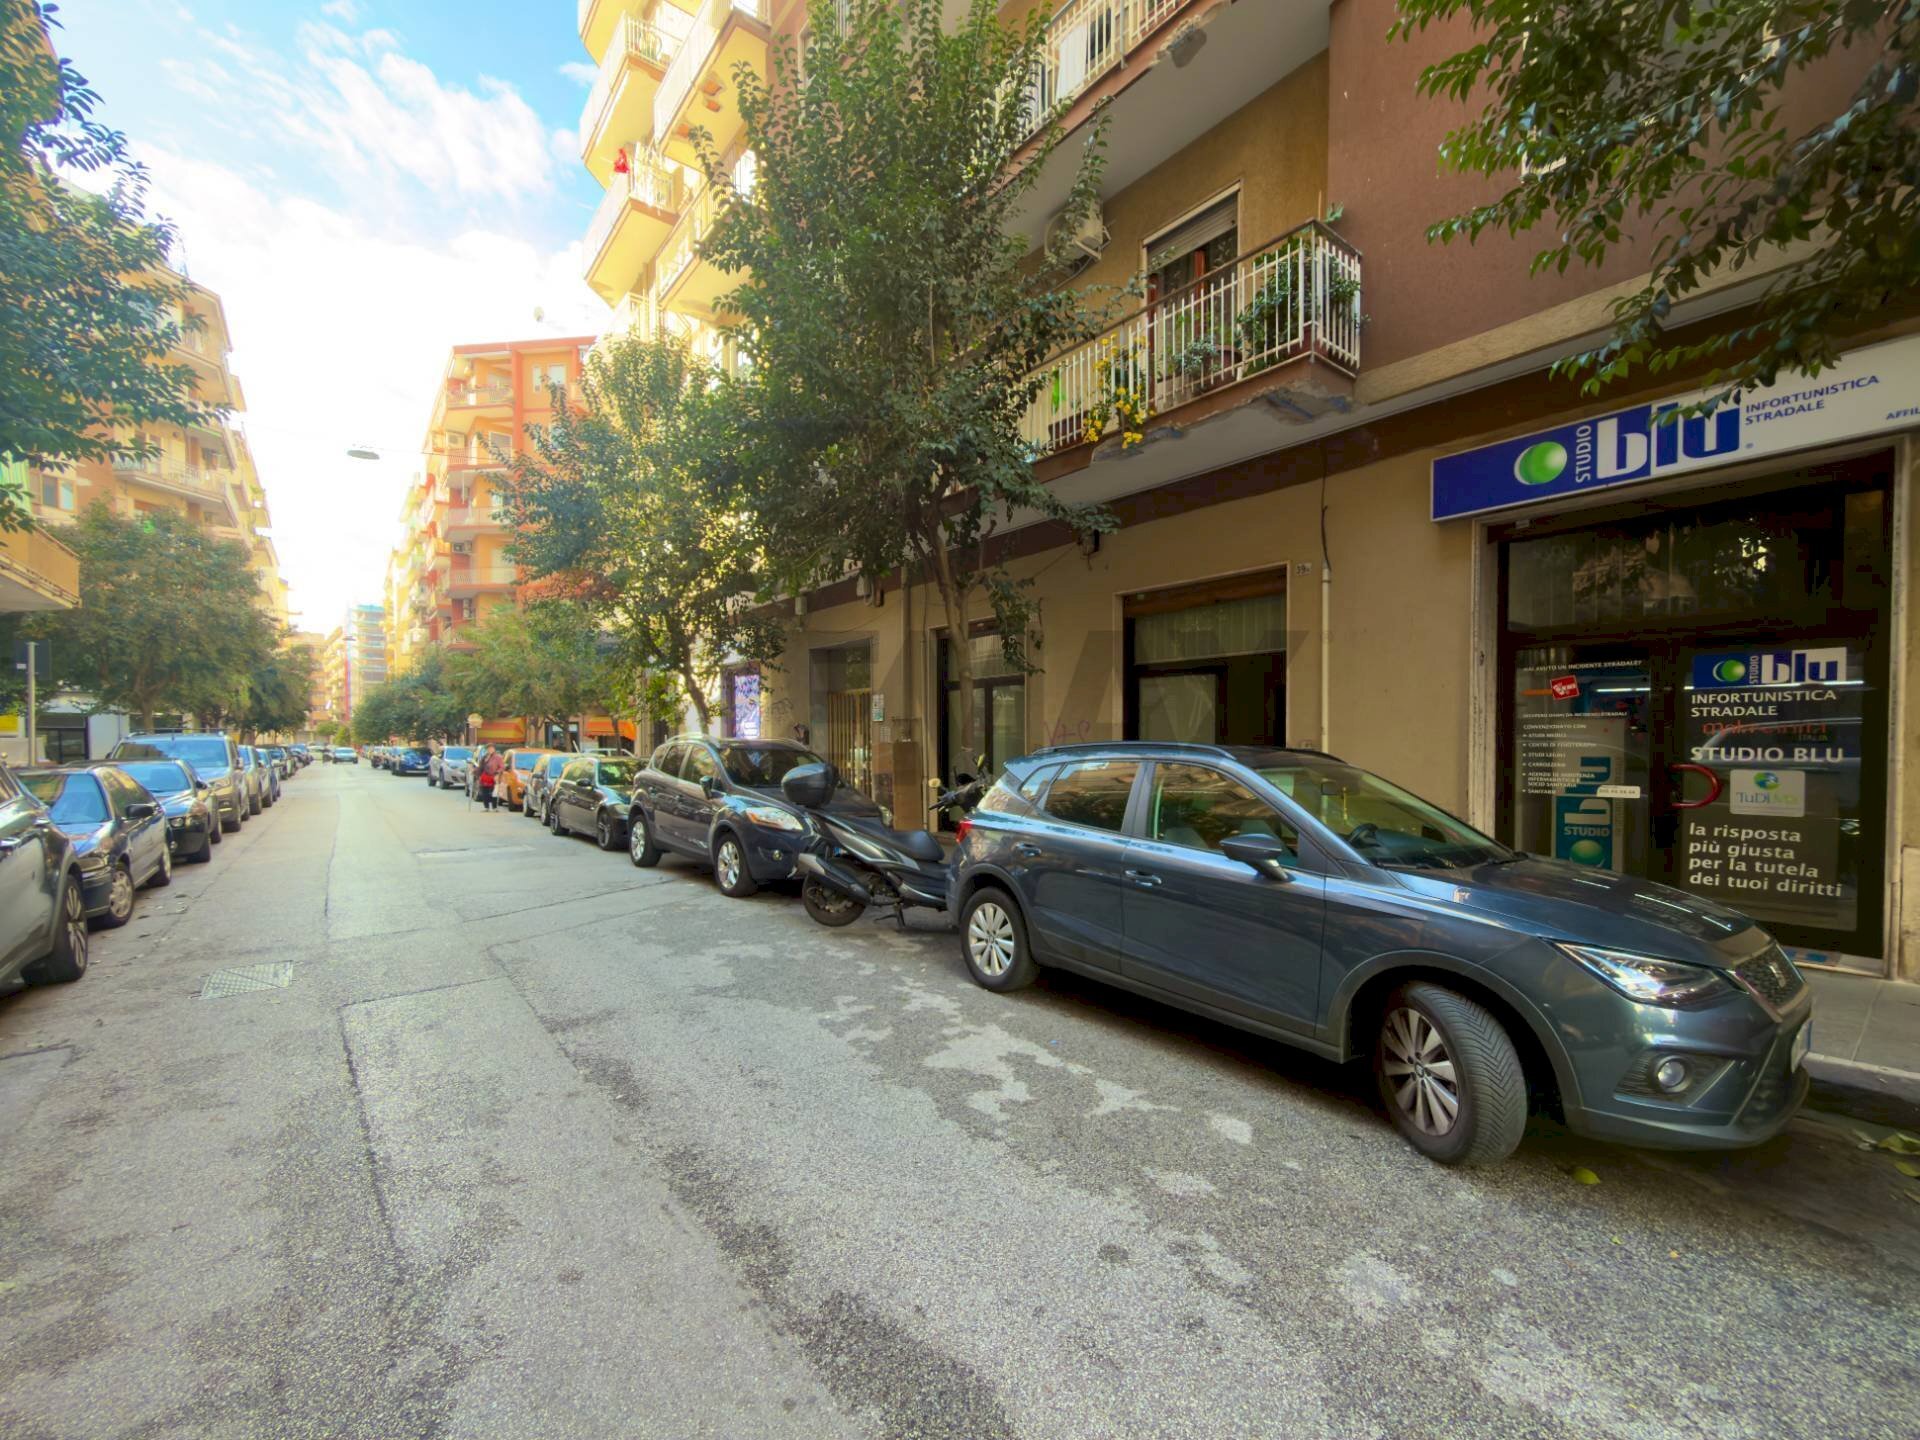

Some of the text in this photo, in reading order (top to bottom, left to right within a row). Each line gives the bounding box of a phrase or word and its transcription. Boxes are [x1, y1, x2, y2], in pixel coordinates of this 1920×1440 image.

[1745, 374, 1881, 414] INFORTUNISTICA
[1744, 398, 1825, 426] STRADALE
[1597, 398, 1739, 480] blu
[1575, 424, 1592, 483] STUDIO
[1749, 655, 1760, 685] STUDIO
[1761, 651, 1838, 684] blu
[1691, 689, 1837, 704] INFORTUNISTICA
[1690, 705, 1778, 717] STRADALE
[1690, 747, 1844, 763] STUDIO BLU
[1564, 825, 1611, 838] STUDIO
[1689, 822, 1801, 843] la risposta
[1689, 839, 1796, 860] più giusta
[1689, 857, 1820, 879] per la tutela
[1689, 873, 1843, 898] dei tuoi diritti
